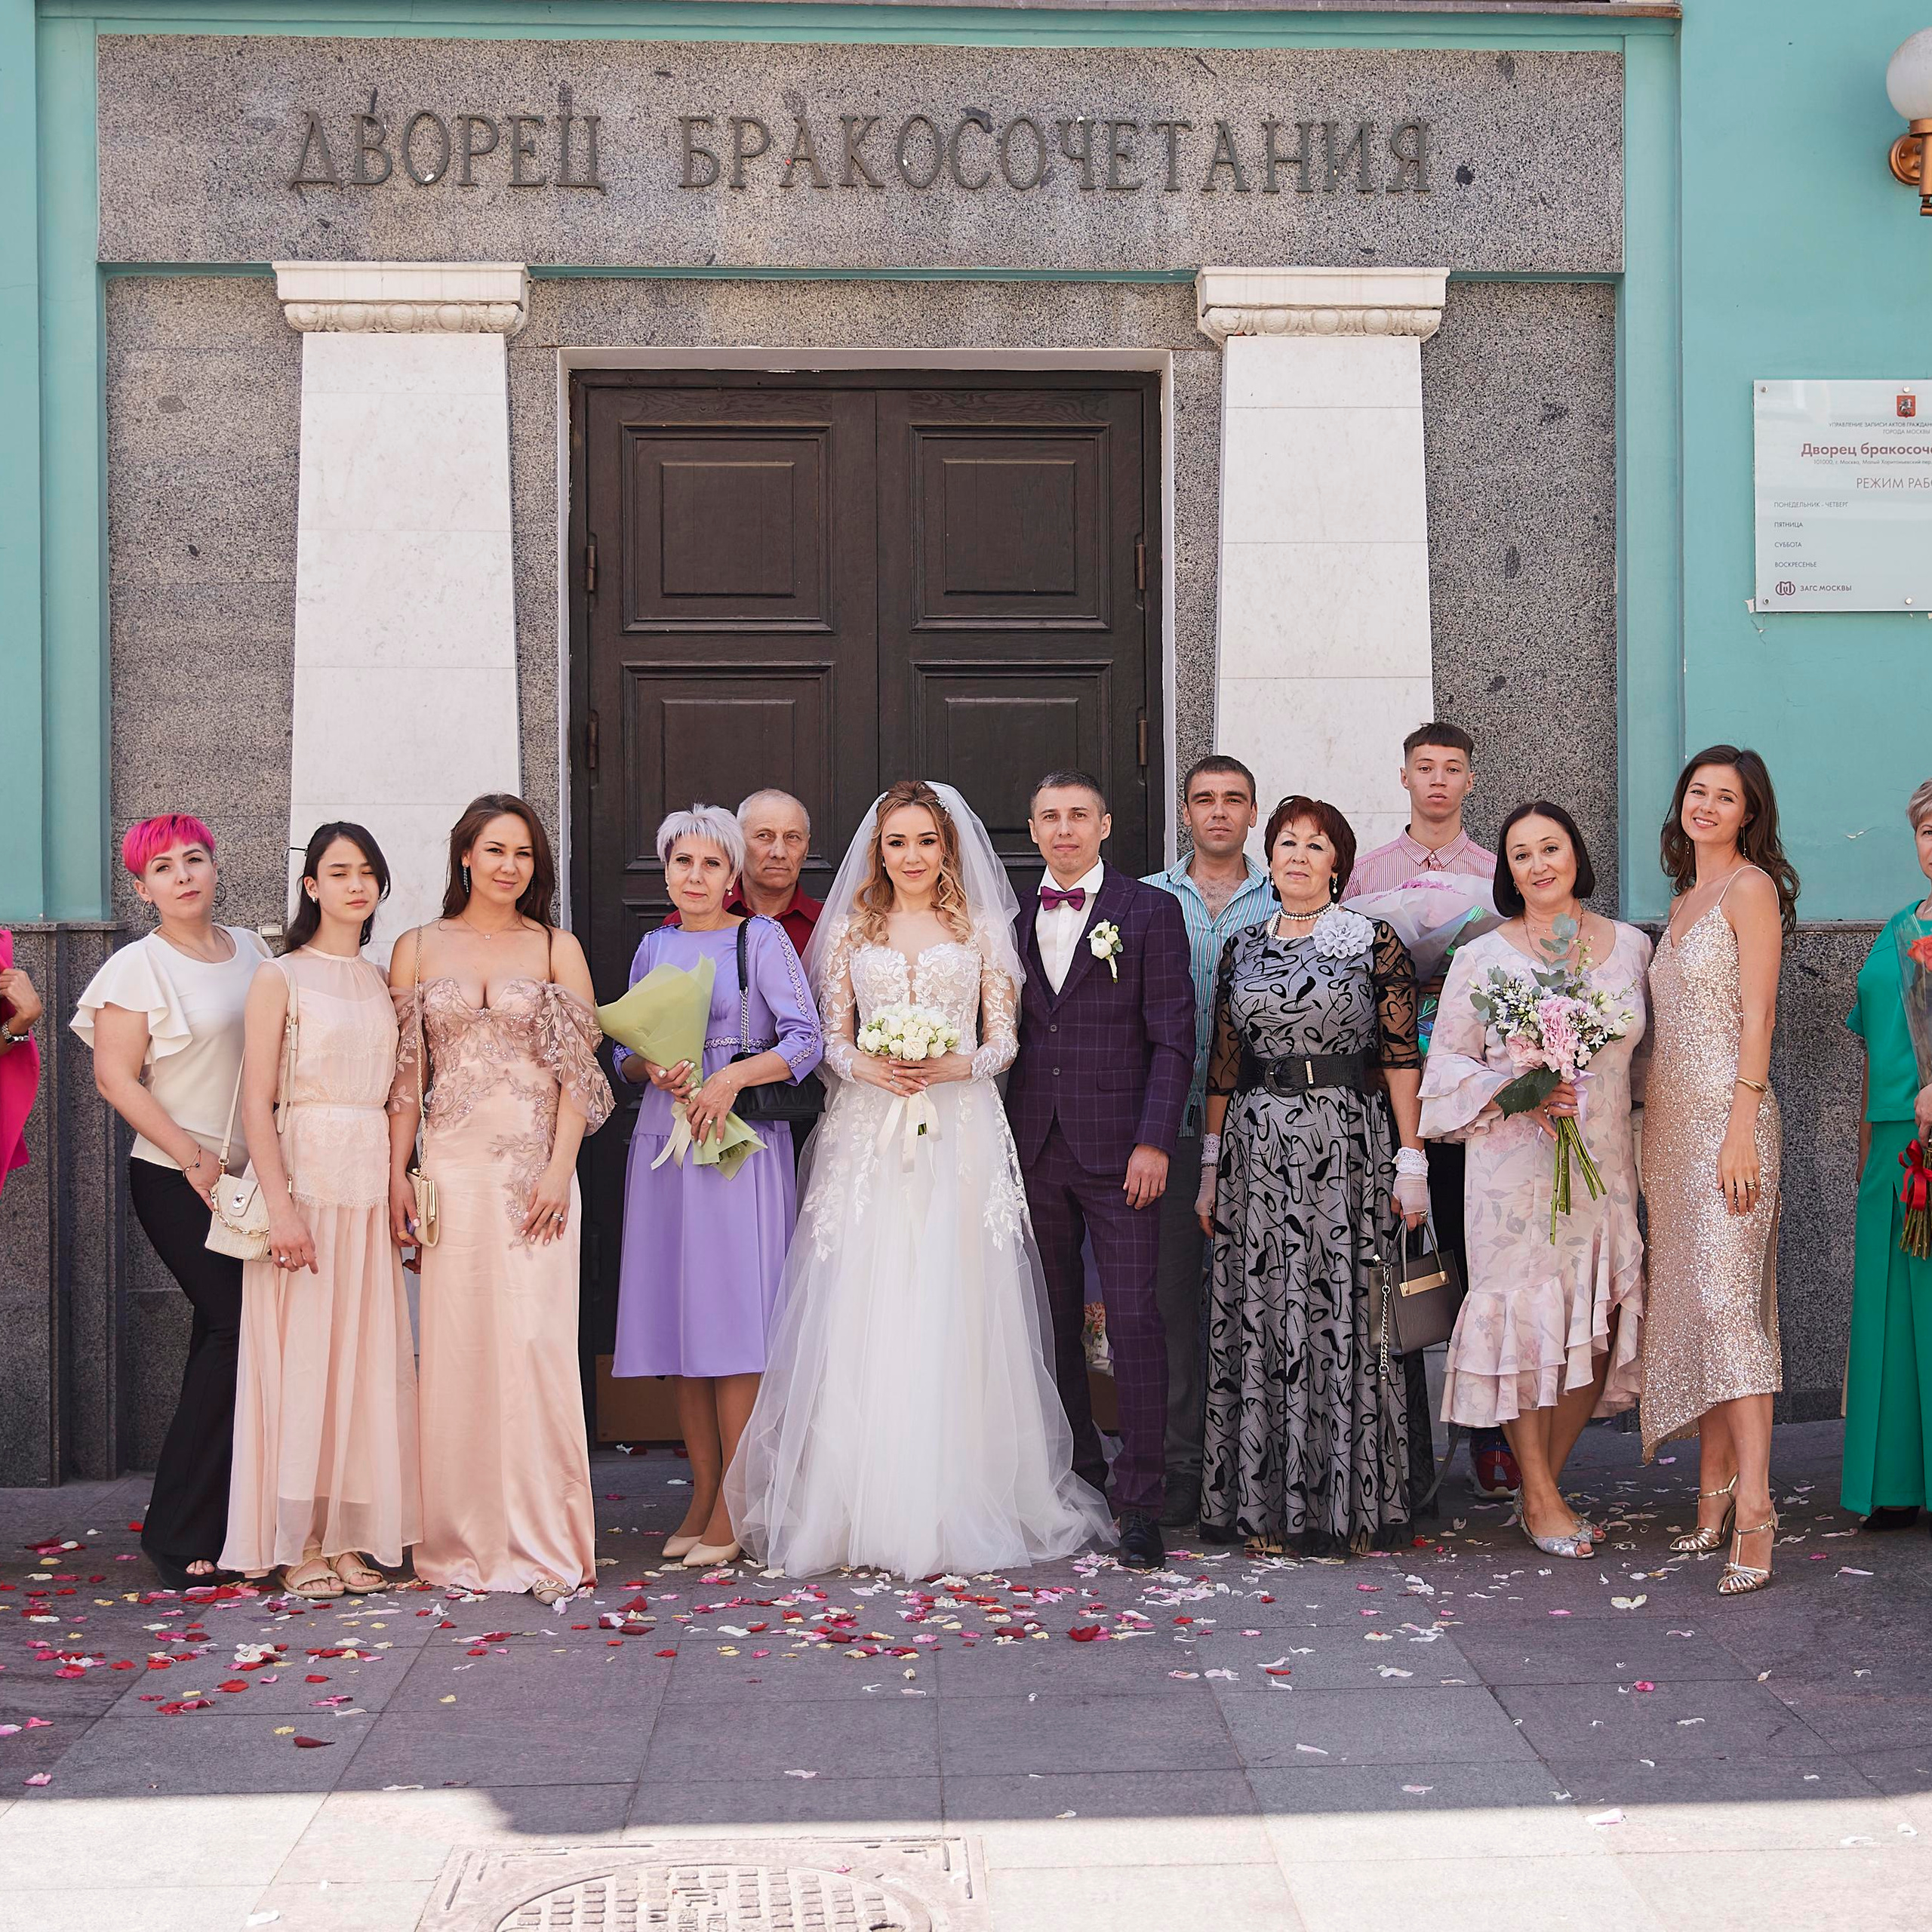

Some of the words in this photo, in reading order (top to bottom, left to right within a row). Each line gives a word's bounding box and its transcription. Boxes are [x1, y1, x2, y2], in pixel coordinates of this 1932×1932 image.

[289, 109, 609, 195] ДВОРЕЦ
[678, 112, 1431, 193] БРАКОСОЧЕТАНИЯ
[1801, 443, 1857, 458] Дворец
[1860, 442, 1932, 458] бракосоч
[1857, 477, 1904, 489] РЕЖИМ
[1909, 477, 1932, 489] РАБ
